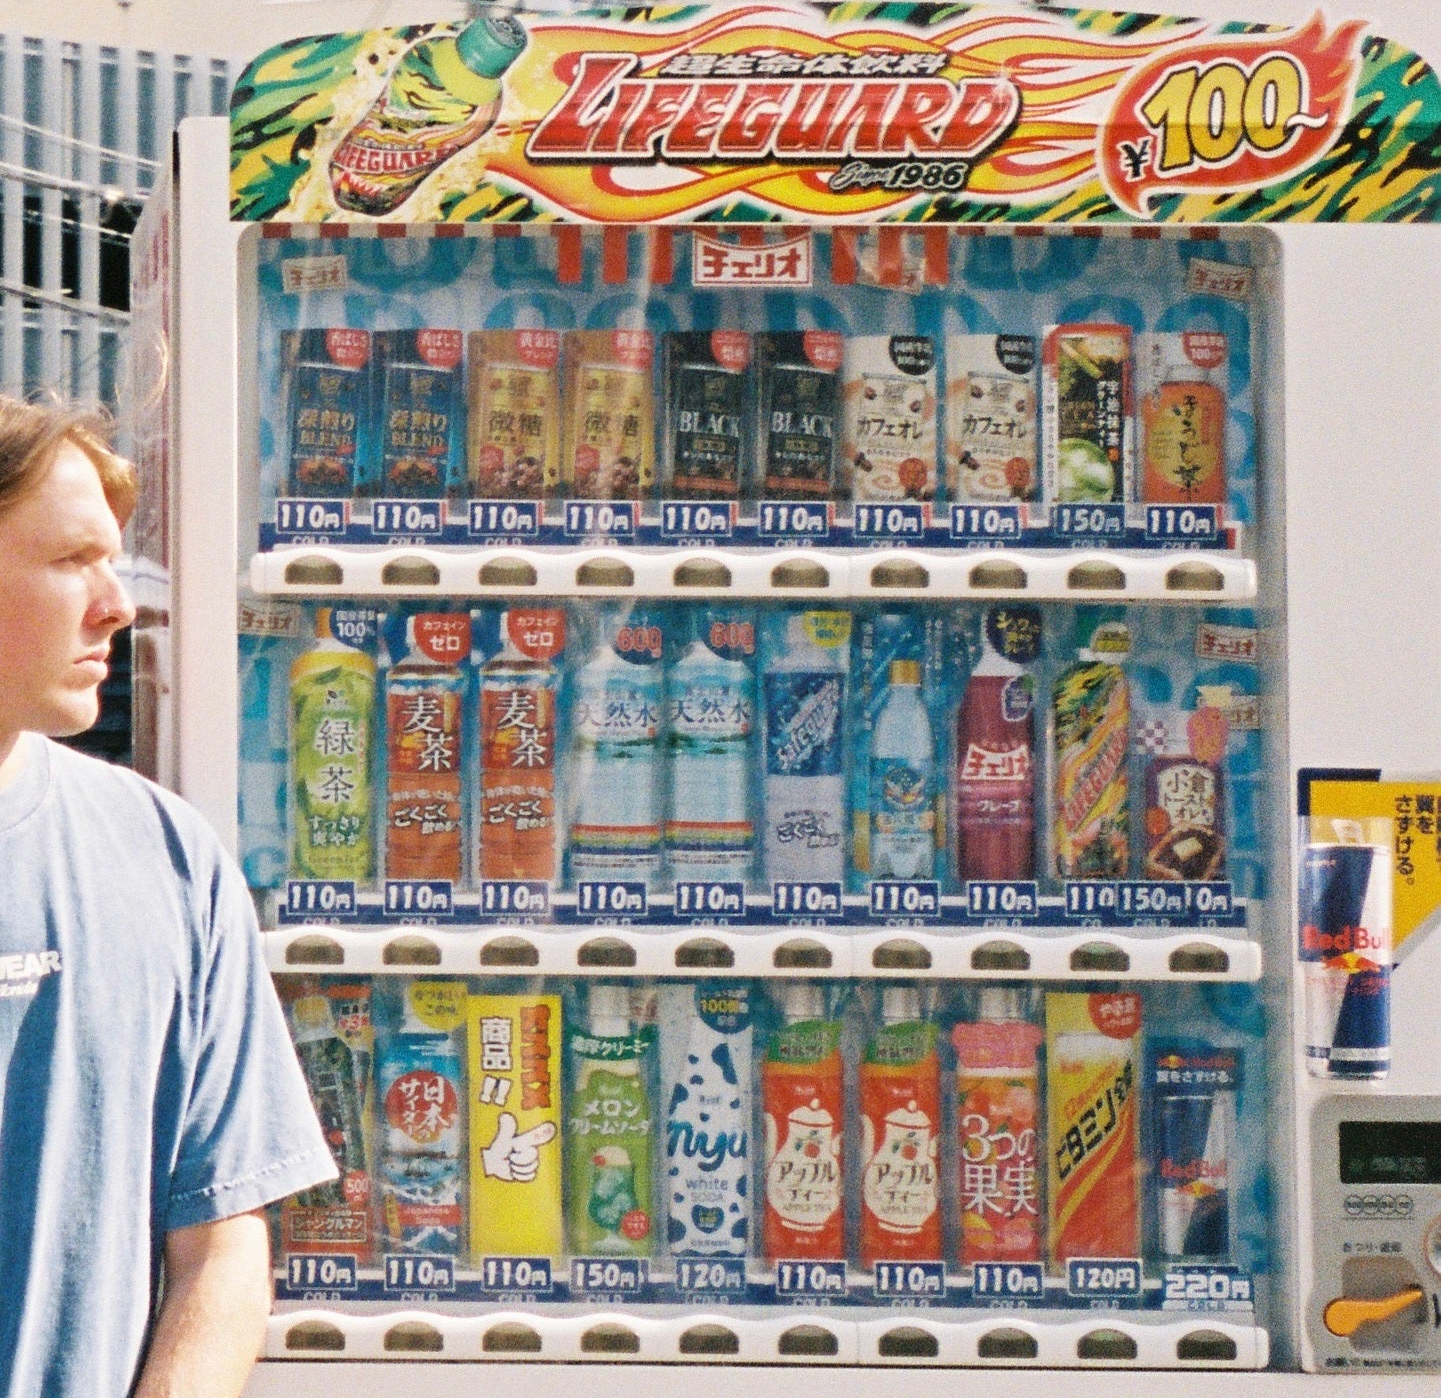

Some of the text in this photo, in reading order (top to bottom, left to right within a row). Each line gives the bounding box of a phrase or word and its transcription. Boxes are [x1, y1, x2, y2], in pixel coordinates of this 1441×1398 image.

[661, 52, 951, 77] 超生命体飲料
[527, 52, 1021, 164] LIFEGUARD
[703, 246, 802, 278] チェリオ
[488, 411, 543, 433] 微糖
[679, 411, 740, 437] BLACK
[772, 411, 833, 437] BLACK
[858, 418, 923, 439] カフェオレ
[963, 416, 1027, 437] カフェオレ
[423, 620, 465, 631] カフェイン
[516, 616, 559, 628] カフェイン
[430, 636, 460, 651] ゼロ
[523, 631, 554, 647] ゼロ
[1203, 634, 1255, 656] チェリオ
[403, 696, 454, 771] 麦茶
[496, 692, 547, 768] 麦茶
[316, 719, 355, 803] 緑茶
[969, 752, 1029, 777] チェリオ
[1167, 774, 1209, 793] 小倉
[394, 806, 447, 827] ごくごく
[489, 802, 541, 823] ごくごく
[976, 799, 1020, 812] グレープ
[1416, 794, 1435, 835] 翼を
[1394, 794, 1415, 886] さずける。
[1302, 924, 1351, 949] Red
[584, 1100, 641, 1118] メロン
[962, 1114, 1033, 1162] 3つの
[778, 1161, 836, 1183] アップル
[874, 1162, 933, 1184] アップル
[1161, 1158, 1198, 1179] Red
[346, 1181, 369, 1193] 500
[686, 1178, 728, 1189] white
[964, 1163, 1037, 1216] 果実
[690, 1192, 724, 1202] SODA
[787, 1189, 822, 1201] ティー
[884, 1190, 920, 1203] ティー
[1077, 1267, 1136, 1290] 120円
[1164, 1274, 1250, 1300] 220円
